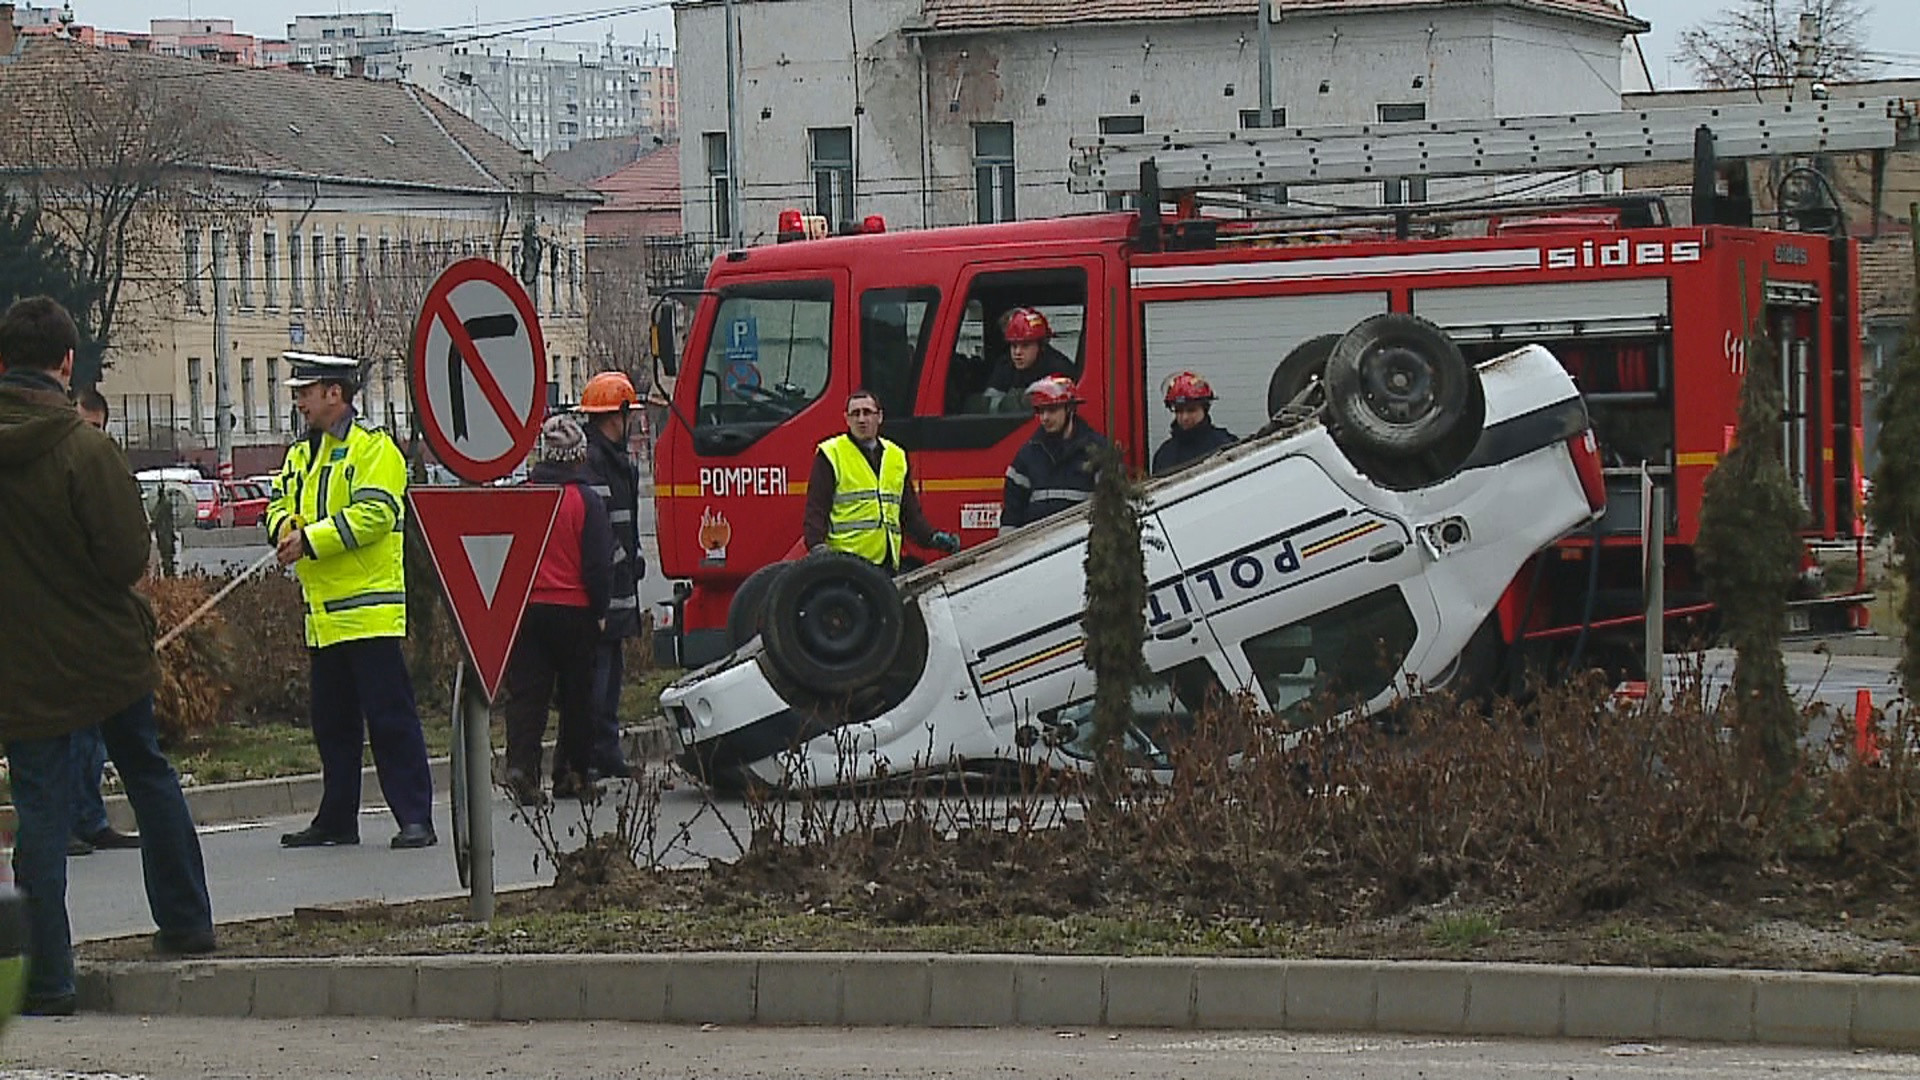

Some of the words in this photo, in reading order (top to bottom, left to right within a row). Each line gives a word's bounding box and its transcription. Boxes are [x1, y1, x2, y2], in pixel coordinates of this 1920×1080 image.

[1548, 238, 1699, 268] sides
[733, 321, 748, 348] P
[700, 466, 787, 497] POMPIERI
